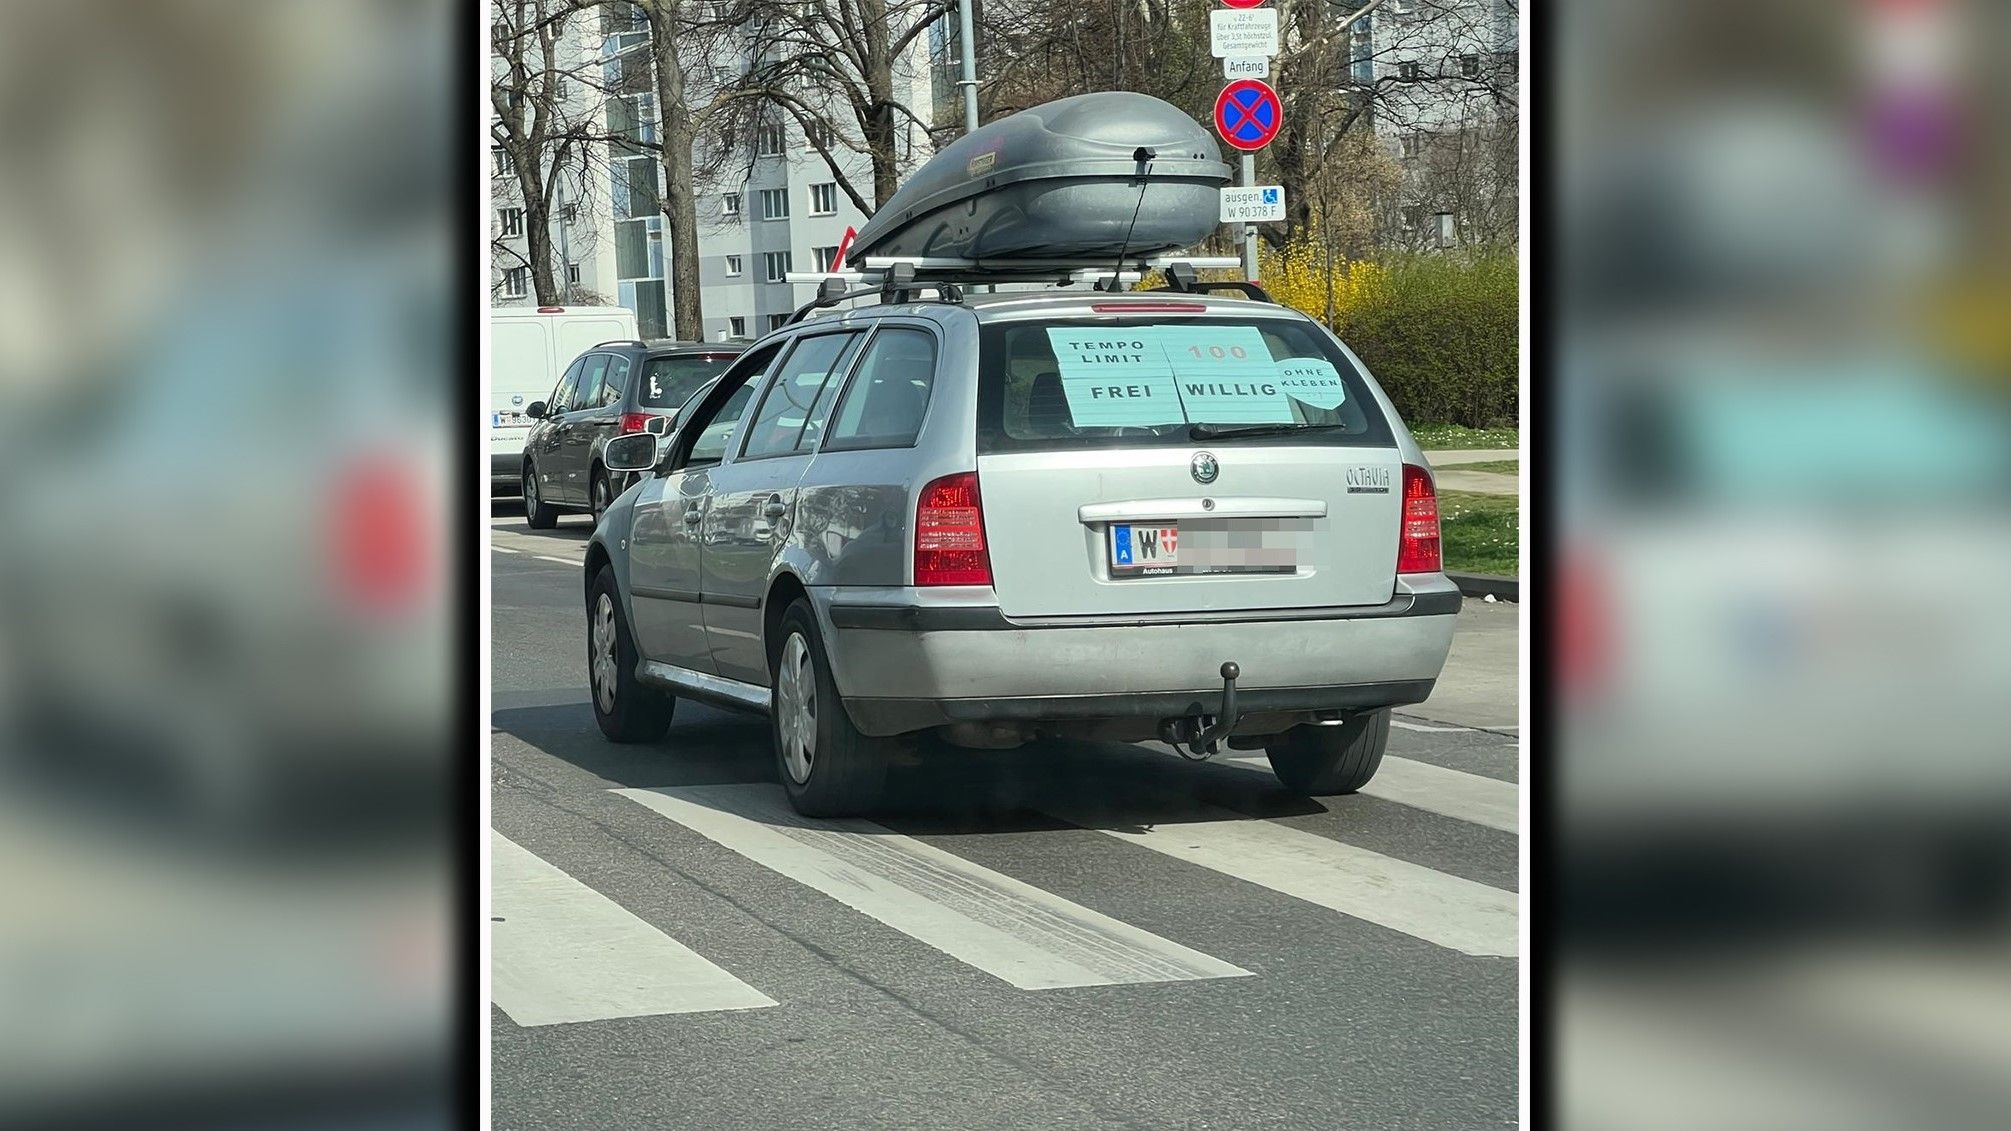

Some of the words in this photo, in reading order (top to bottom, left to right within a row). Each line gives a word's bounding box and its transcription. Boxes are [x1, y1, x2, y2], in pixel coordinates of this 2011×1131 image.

[1228, 23, 1272, 32] Kraftfahrzeuge
[1222, 41, 1268, 50] Gesamtgewicht
[1229, 61, 1264, 74] Anfang
[1225, 193, 1263, 204] ausgen.
[1228, 207, 1236, 218] W
[1239, 206, 1268, 218] 90378
[1271, 206, 1276, 216] F
[1068, 341, 1144, 350] TEMPO
[1188, 345, 1248, 360] 100
[1081, 354, 1142, 363] LIMIT
[1284, 368, 1324, 377] OHNE
[1280, 379, 1338, 387] KLEBEN
[1090, 384, 1152, 399] FREI
[1185, 383, 1276, 396] WILLIG
[1346, 467, 1390, 486] OCTAVIA
[1120, 549, 1129, 560] A
[1138, 529, 1158, 560] W
